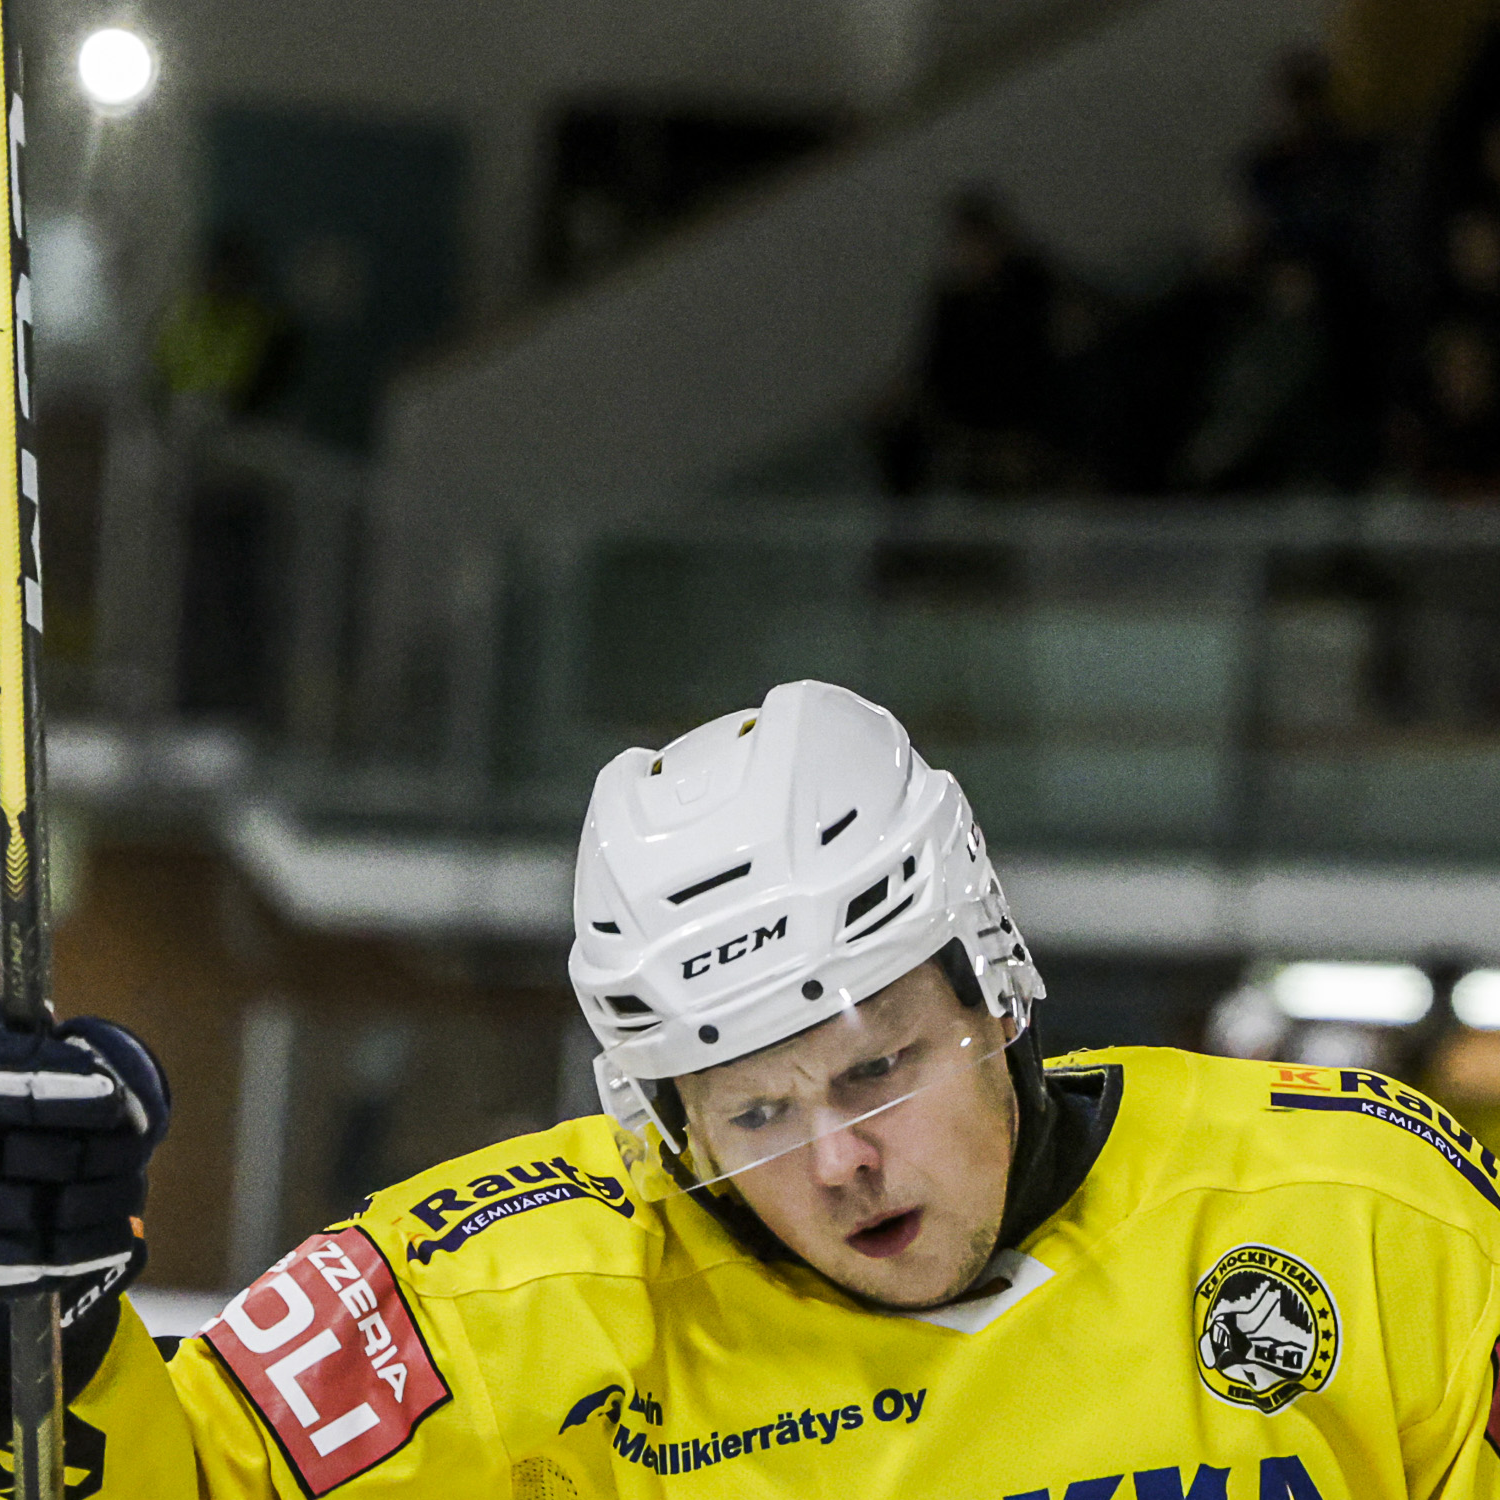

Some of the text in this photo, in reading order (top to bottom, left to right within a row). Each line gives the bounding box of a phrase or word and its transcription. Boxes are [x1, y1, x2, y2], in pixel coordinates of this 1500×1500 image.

[681, 914, 788, 979] CCM
[1361, 1102, 1462, 1168] KEMIJÄRVI
[461, 1186, 572, 1235] KEMIJÄRVI
[1200, 1251, 1319, 1300] ICE HOCKEY TEAM
[200, 1272, 381, 1458] OLI
[872, 1387, 928, 1424] Oy
